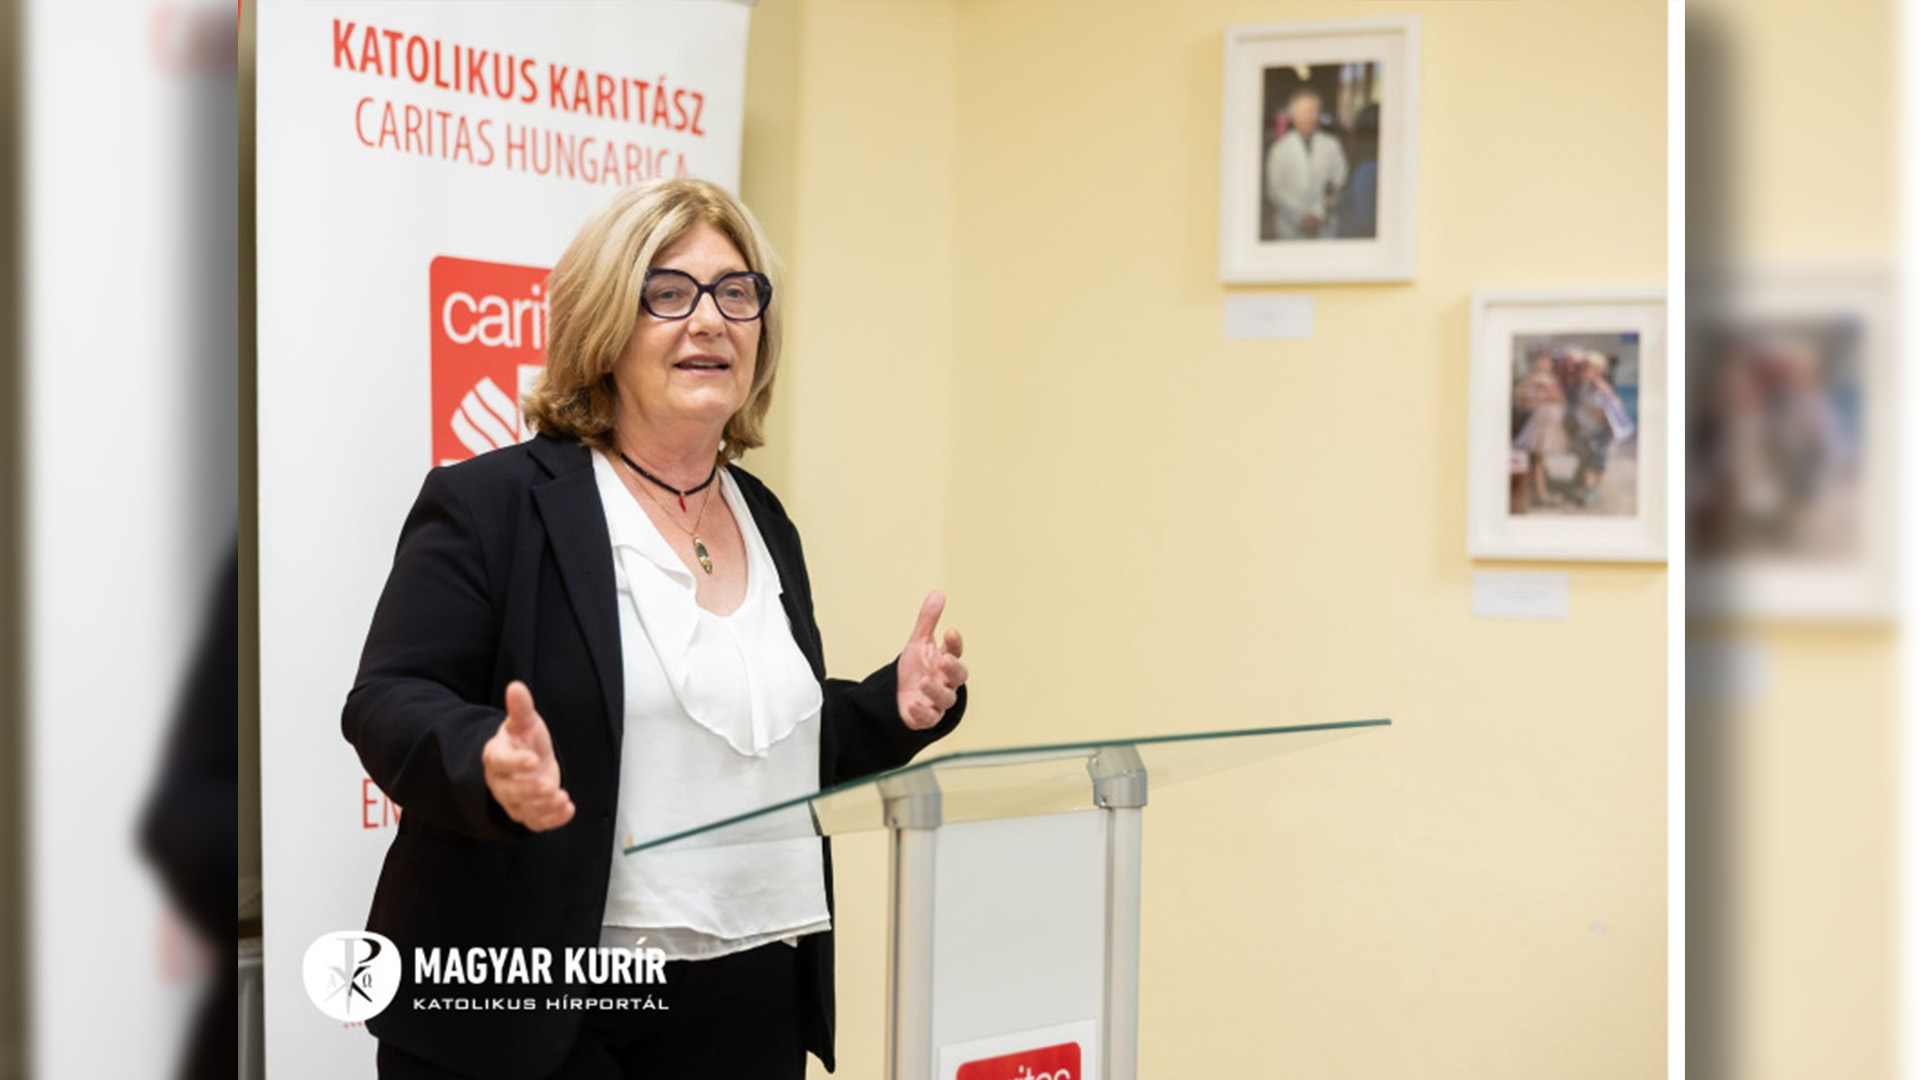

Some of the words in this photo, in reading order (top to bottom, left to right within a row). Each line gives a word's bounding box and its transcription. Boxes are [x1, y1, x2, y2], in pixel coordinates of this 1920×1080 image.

[332, 18, 538, 105] KATOLIKUS
[549, 62, 706, 136] KARITÁSZ
[355, 97, 495, 168] CARITAS
